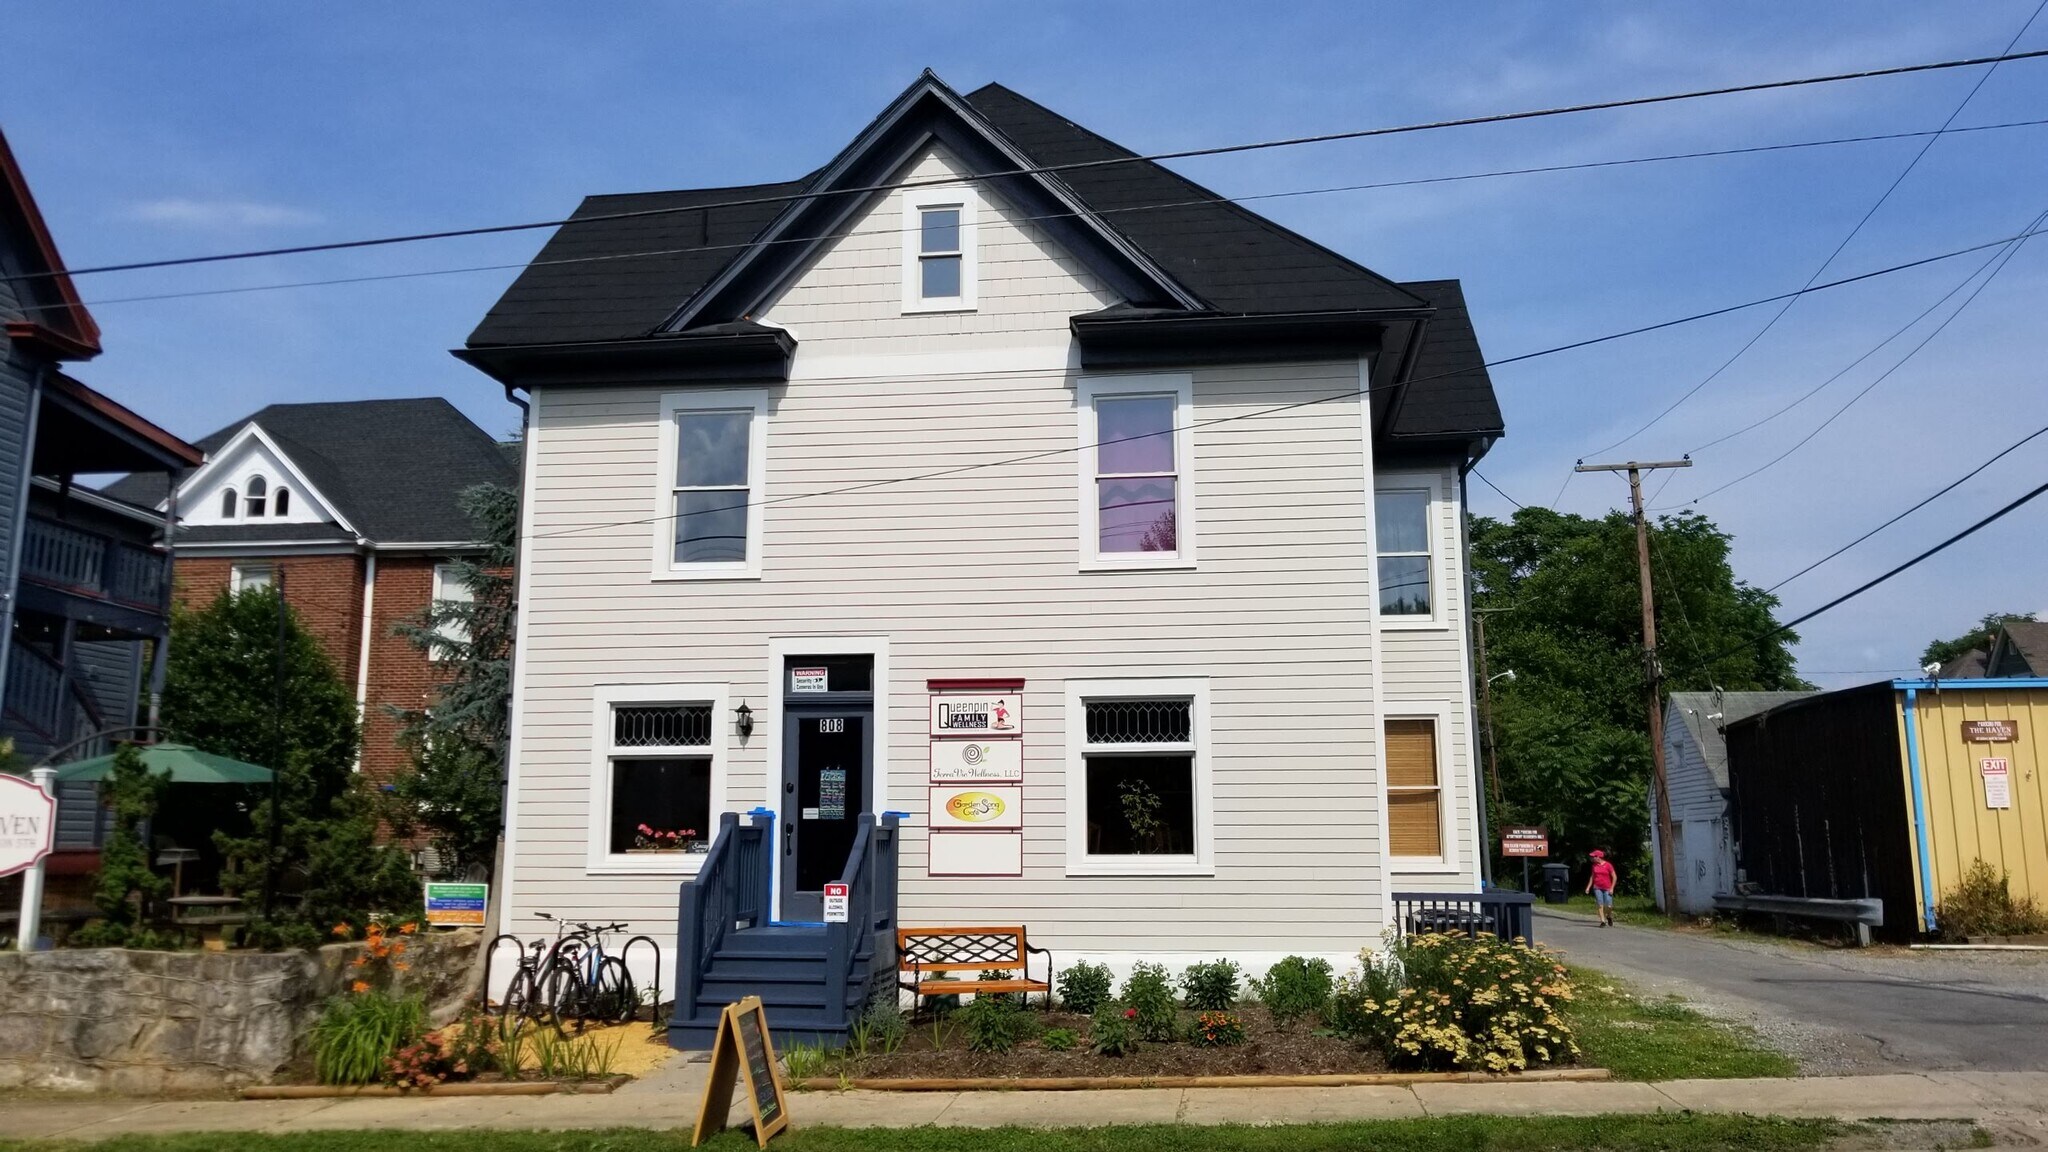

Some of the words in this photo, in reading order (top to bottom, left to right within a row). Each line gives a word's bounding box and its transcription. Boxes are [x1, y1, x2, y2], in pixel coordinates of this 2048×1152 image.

[952, 714, 987, 722] FAMILY
[821, 719, 842, 732] 808
[1985, 726, 2012, 734] HAVEN
[1983, 760, 2006, 770] EXIT
[953, 799, 981, 808] Garden
[830, 887, 842, 895] NO
